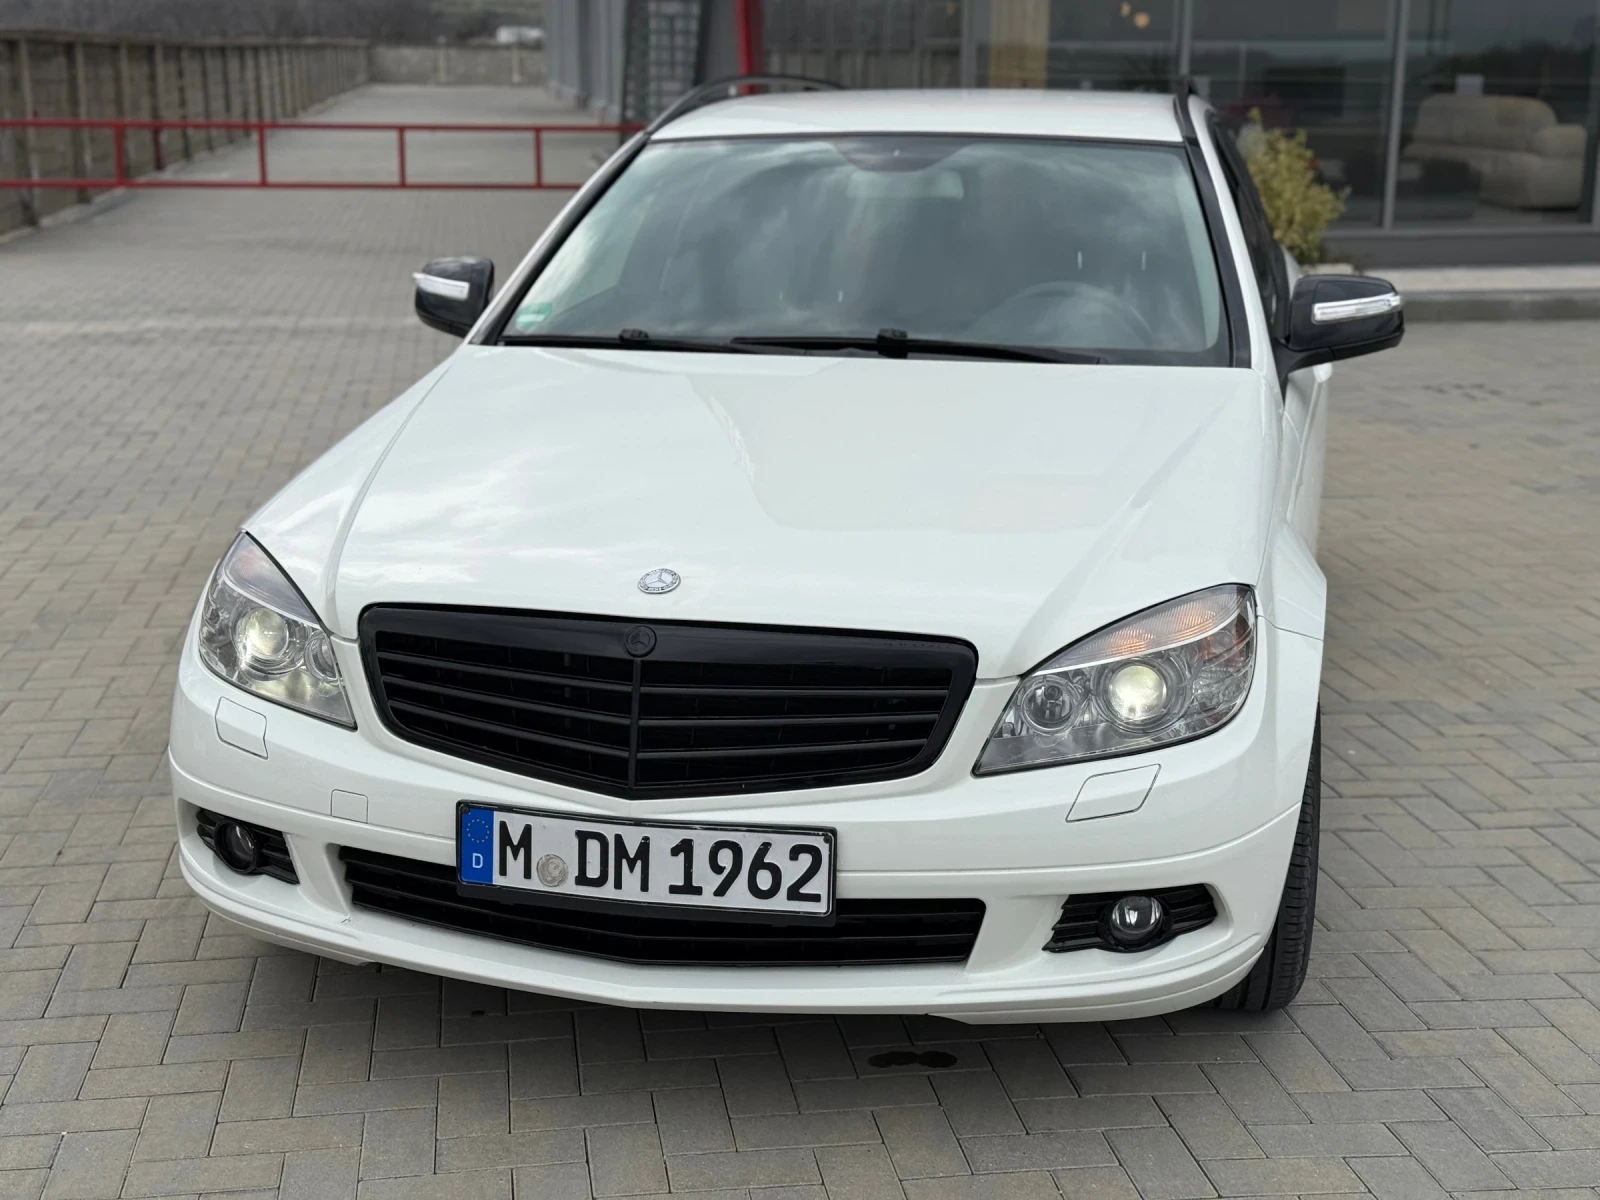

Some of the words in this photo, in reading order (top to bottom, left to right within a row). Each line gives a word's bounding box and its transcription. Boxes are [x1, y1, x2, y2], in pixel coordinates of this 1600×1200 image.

[472, 853, 484, 869] D
[499, 820, 532, 880] M
[575, 830, 651, 893] DM
[668, 838, 823, 904] 1962
